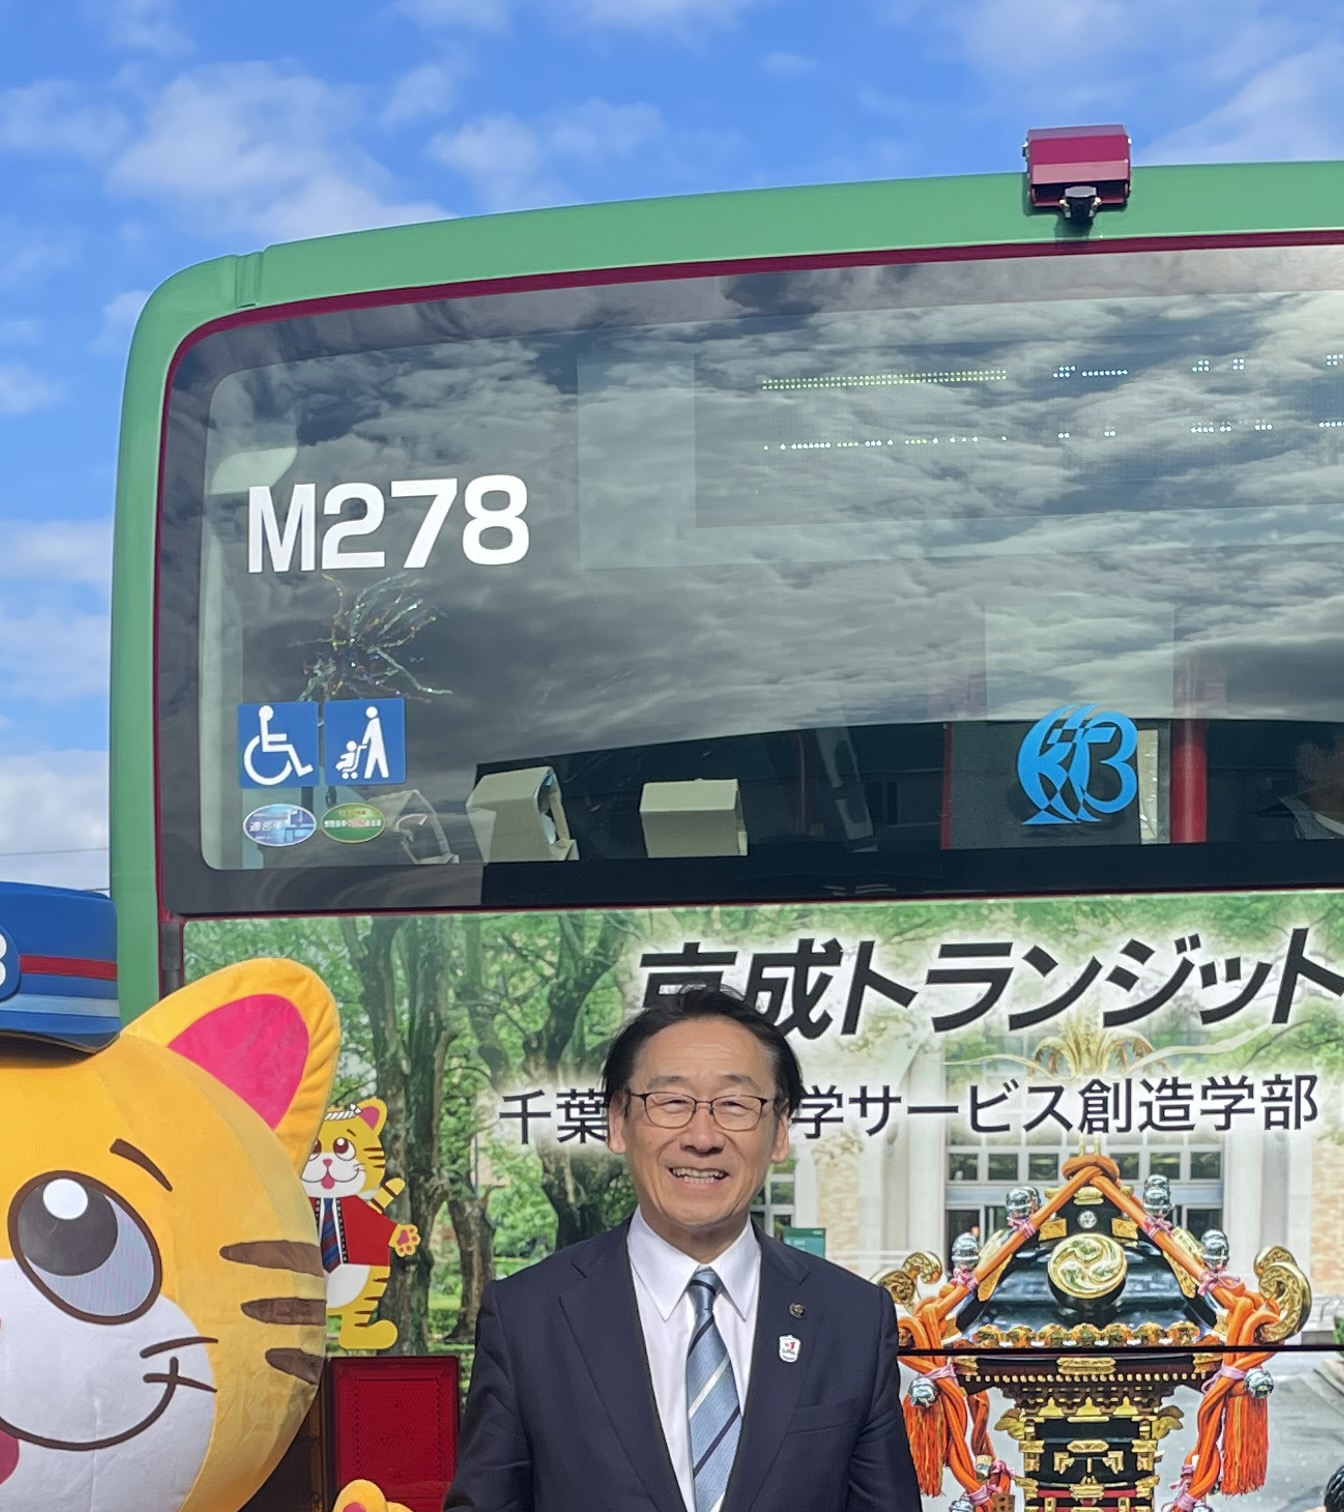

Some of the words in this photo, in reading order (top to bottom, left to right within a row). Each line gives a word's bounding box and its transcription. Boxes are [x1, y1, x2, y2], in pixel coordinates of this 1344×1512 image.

[249, 474, 530, 574] M278
[499, 1074, 1317, 1145] 千葉学サービス創造学部
